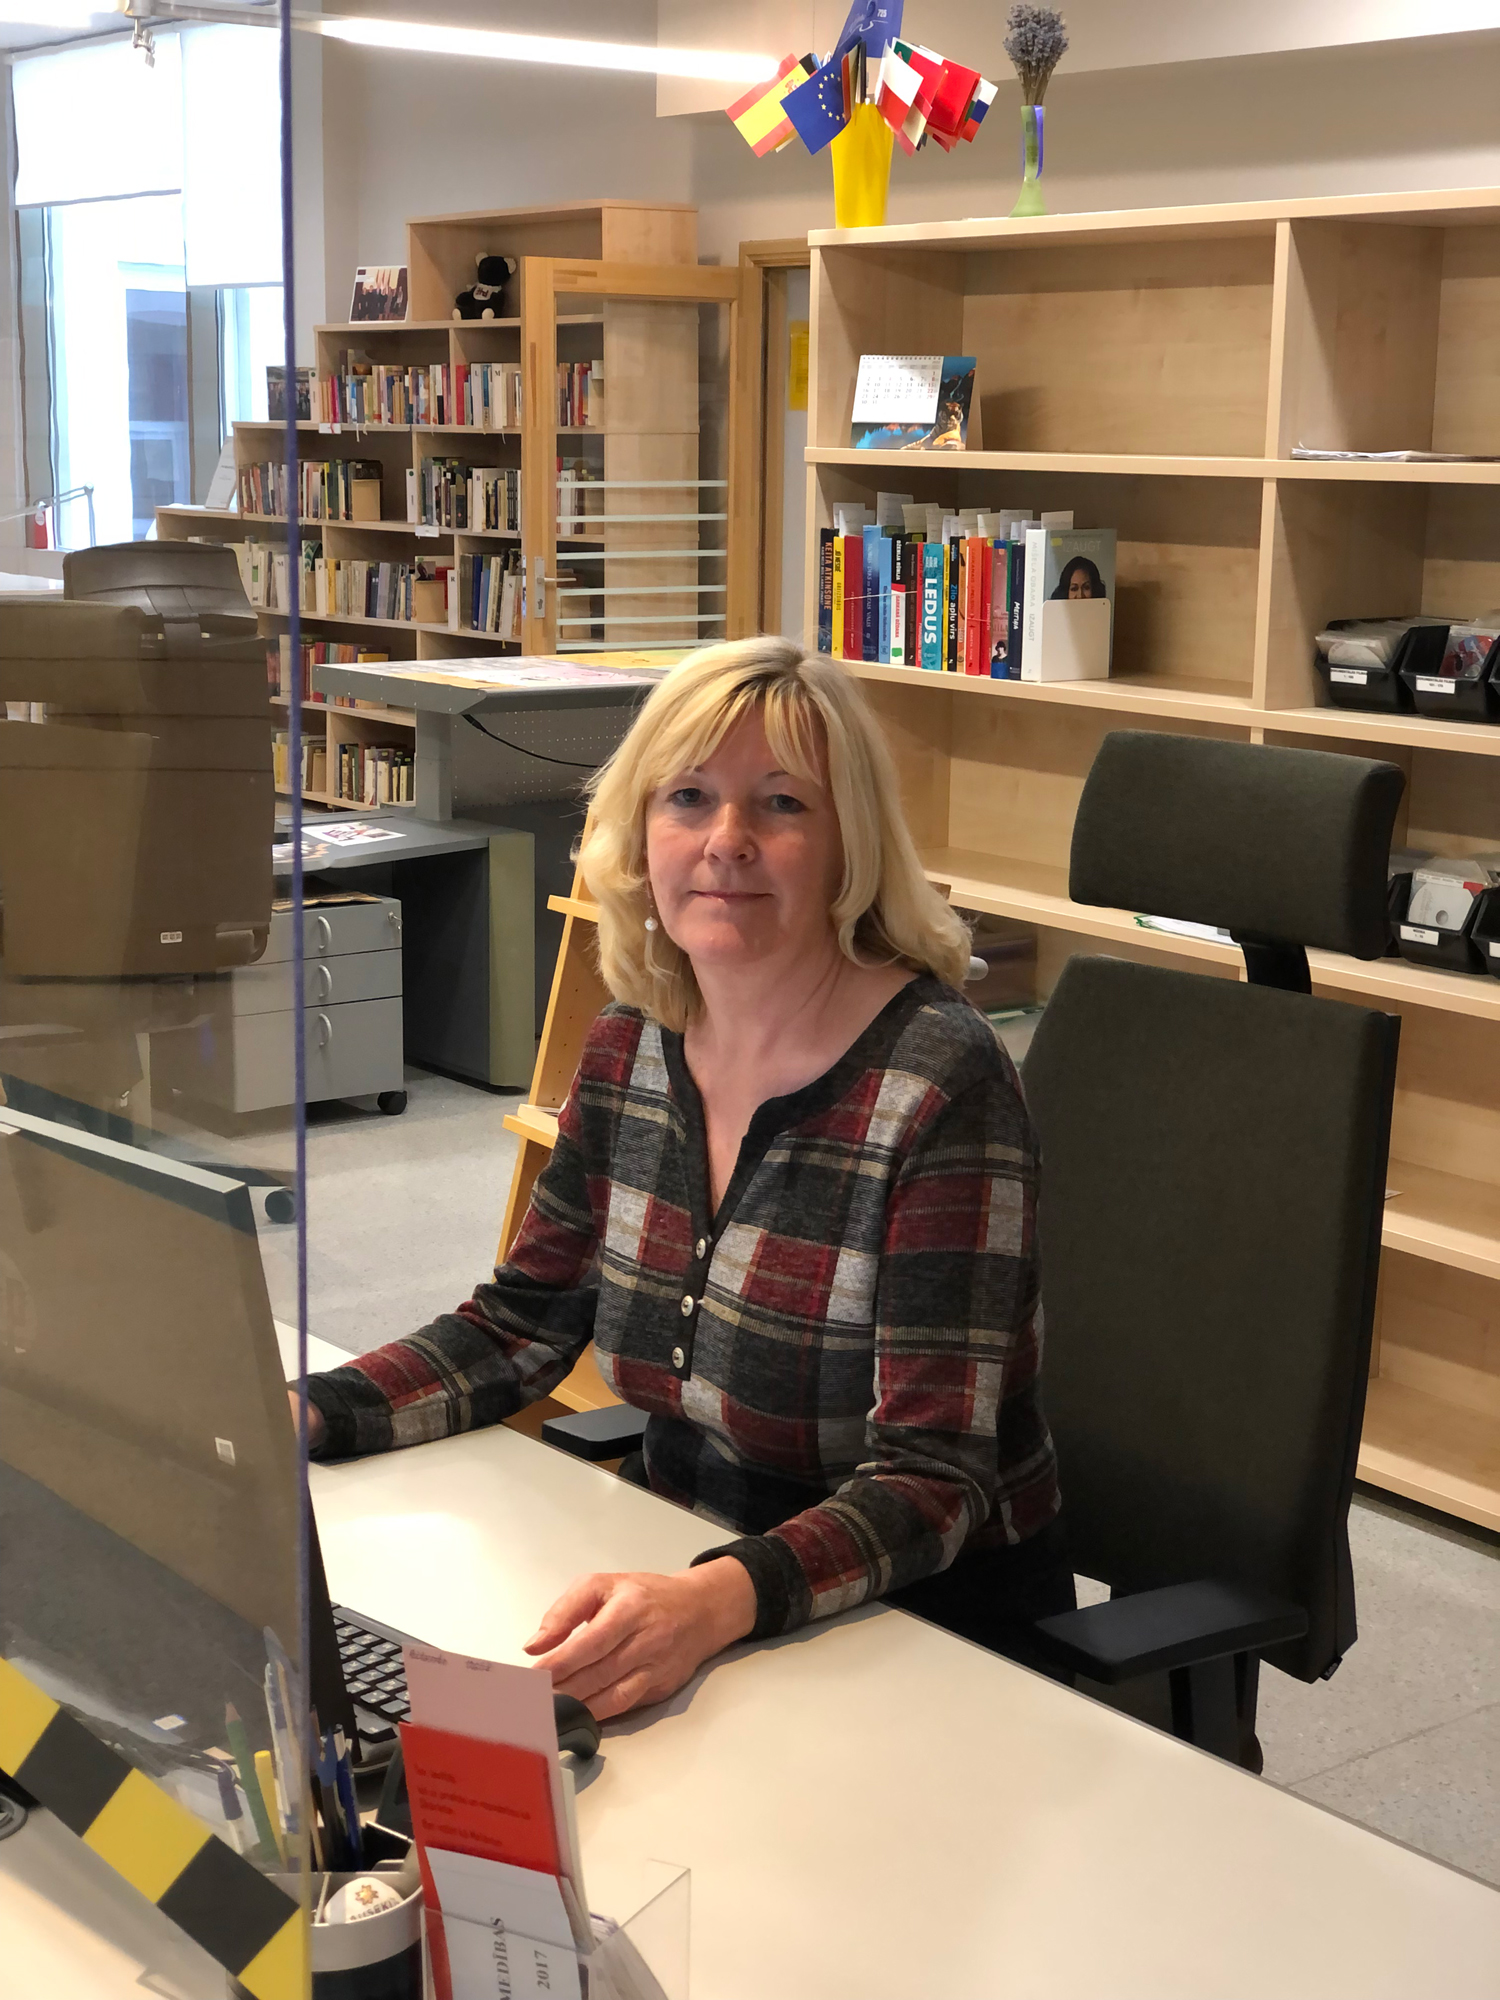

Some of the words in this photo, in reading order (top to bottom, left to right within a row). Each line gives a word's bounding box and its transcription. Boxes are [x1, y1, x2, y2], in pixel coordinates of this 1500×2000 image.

[824, 541, 833, 565] KEITA
[1031, 541, 1040, 573] MIŠELA
[1062, 540, 1102, 553] IZAUGT
[823, 567, 833, 611] ATKINSONE
[1029, 575, 1038, 607] OBAMA
[924, 577, 938, 644] LEDUS
[949, 602, 957, 621] apļu
[1028, 613, 1036, 642] IZAUGT
[534, 1949, 551, 1990] 2017
